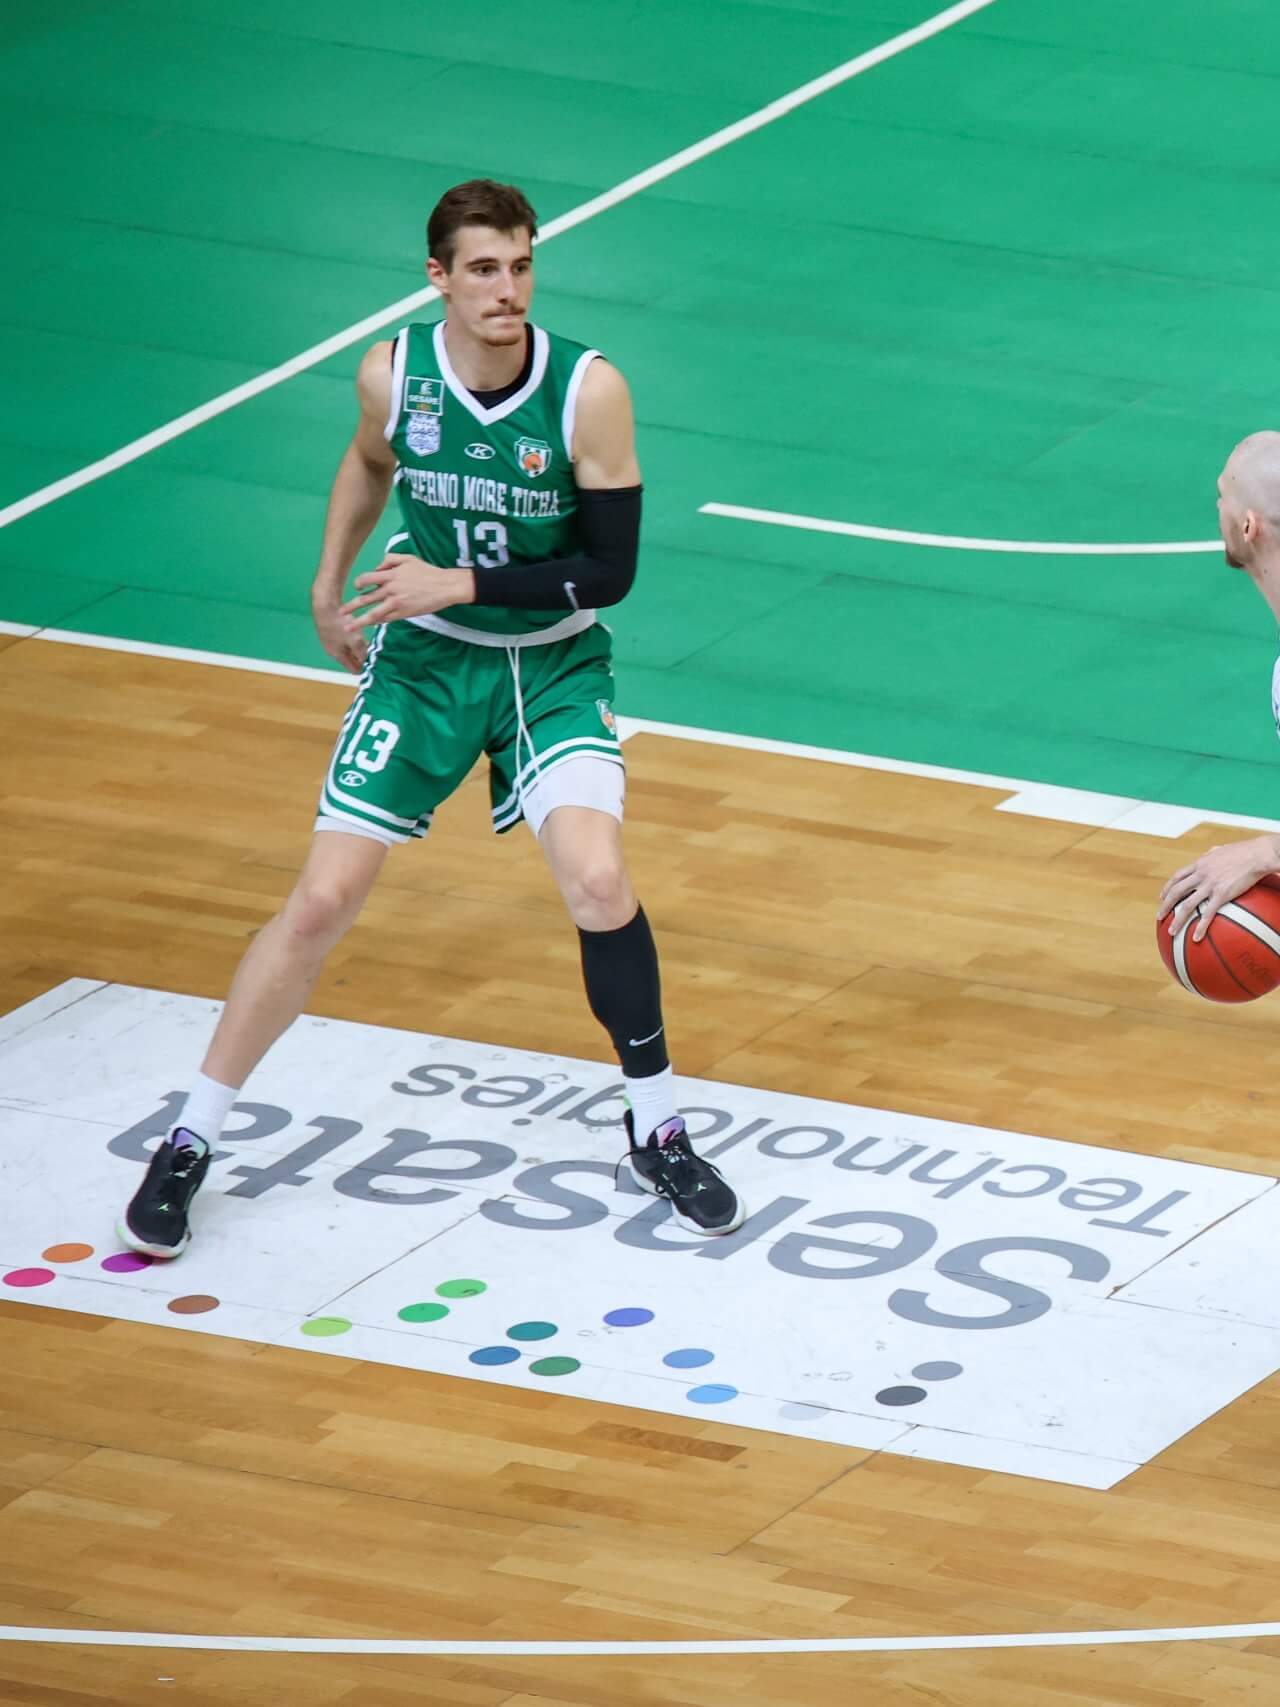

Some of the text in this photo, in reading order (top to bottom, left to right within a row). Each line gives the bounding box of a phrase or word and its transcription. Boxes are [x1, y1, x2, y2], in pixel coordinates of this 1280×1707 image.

[463, 475, 507, 516] MORE
[511, 486, 561, 518] TICHA
[452, 518, 511, 569] 13
[339, 713, 401, 774] 13
[390, 1062, 1193, 1238] Technologies
[106, 1090, 1112, 1331] Sensata
